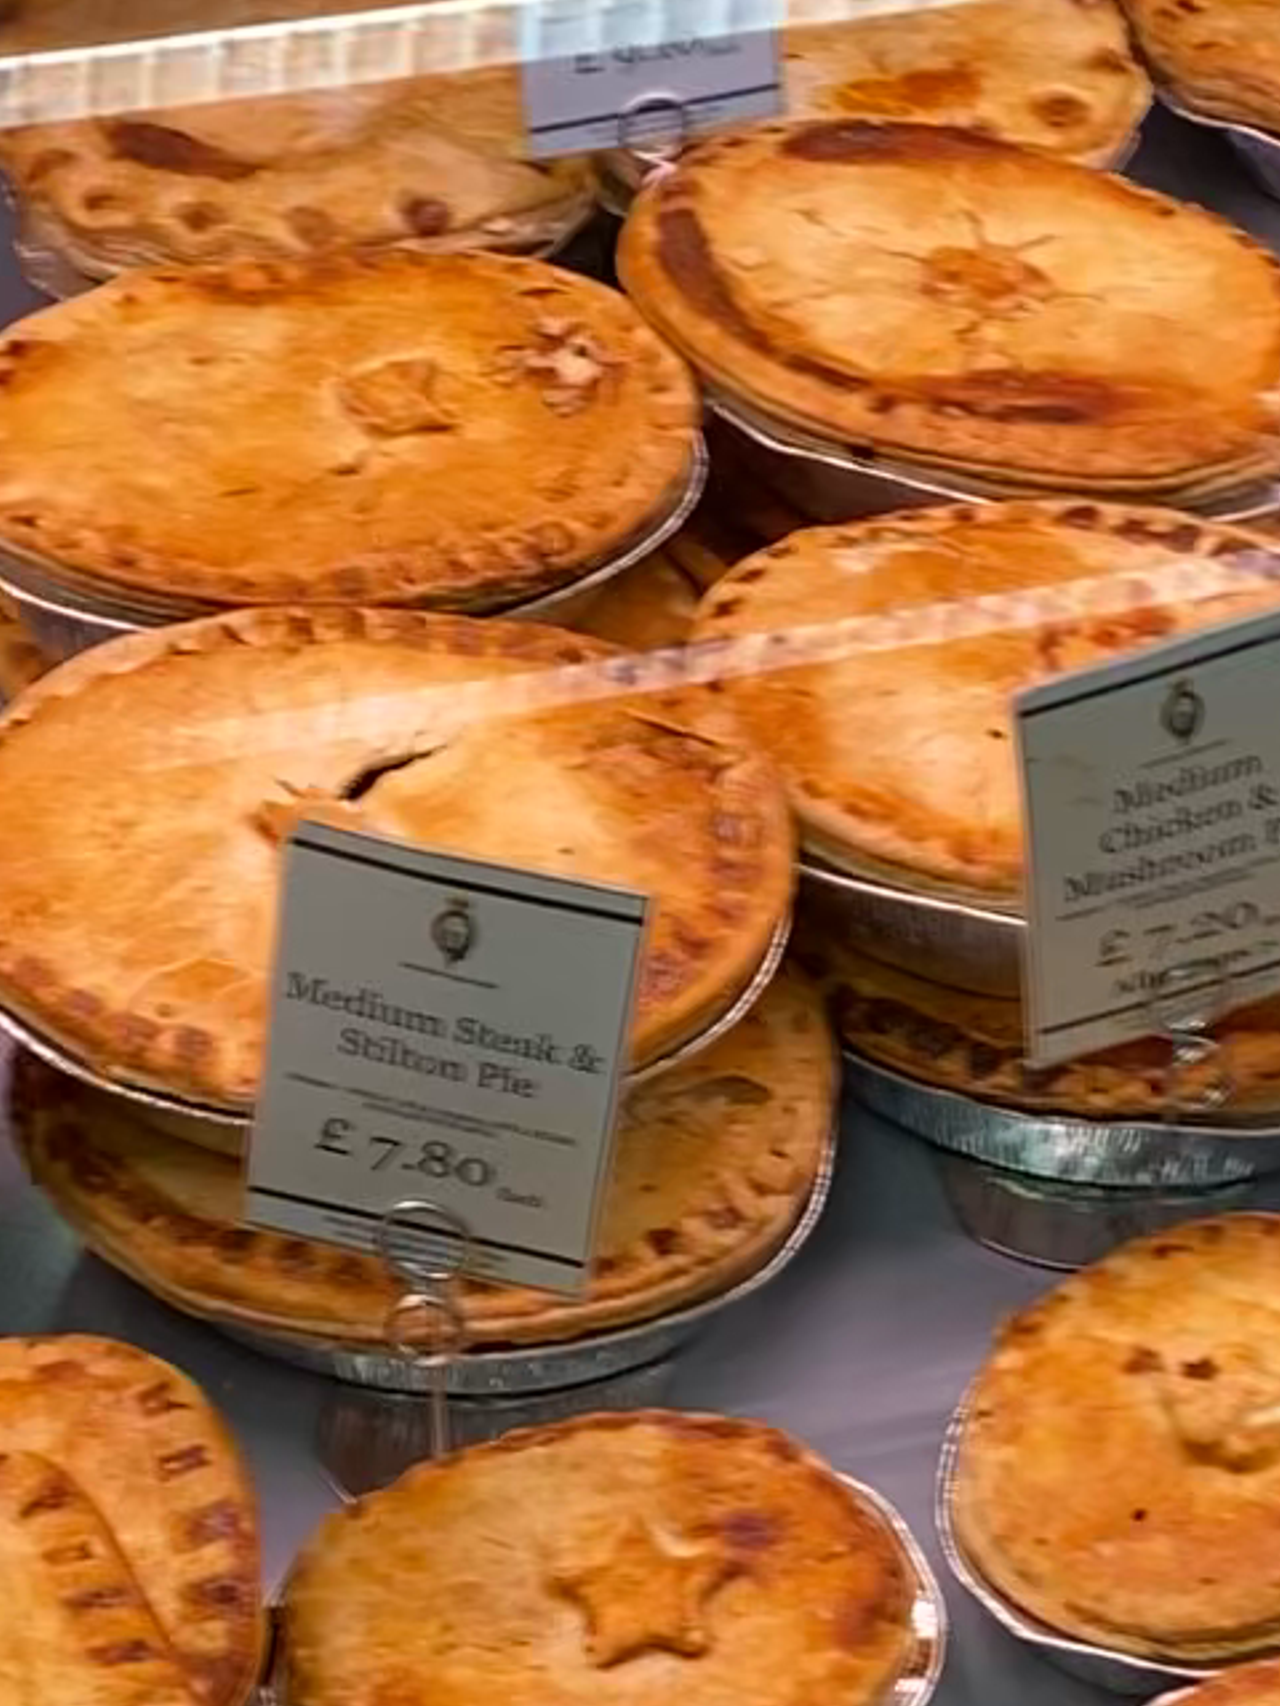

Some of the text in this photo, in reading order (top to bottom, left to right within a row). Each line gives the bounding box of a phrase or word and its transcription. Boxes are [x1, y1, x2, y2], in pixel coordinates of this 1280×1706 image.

[1099, 782, 1280, 855] Chicken &
[1112, 754, 1263, 815] Medium
[1062, 832, 1258, 904] Mushroom
[285, 970, 606, 1074] Medium Steak &
[336, 1027, 539, 1100] Stilton Pie
